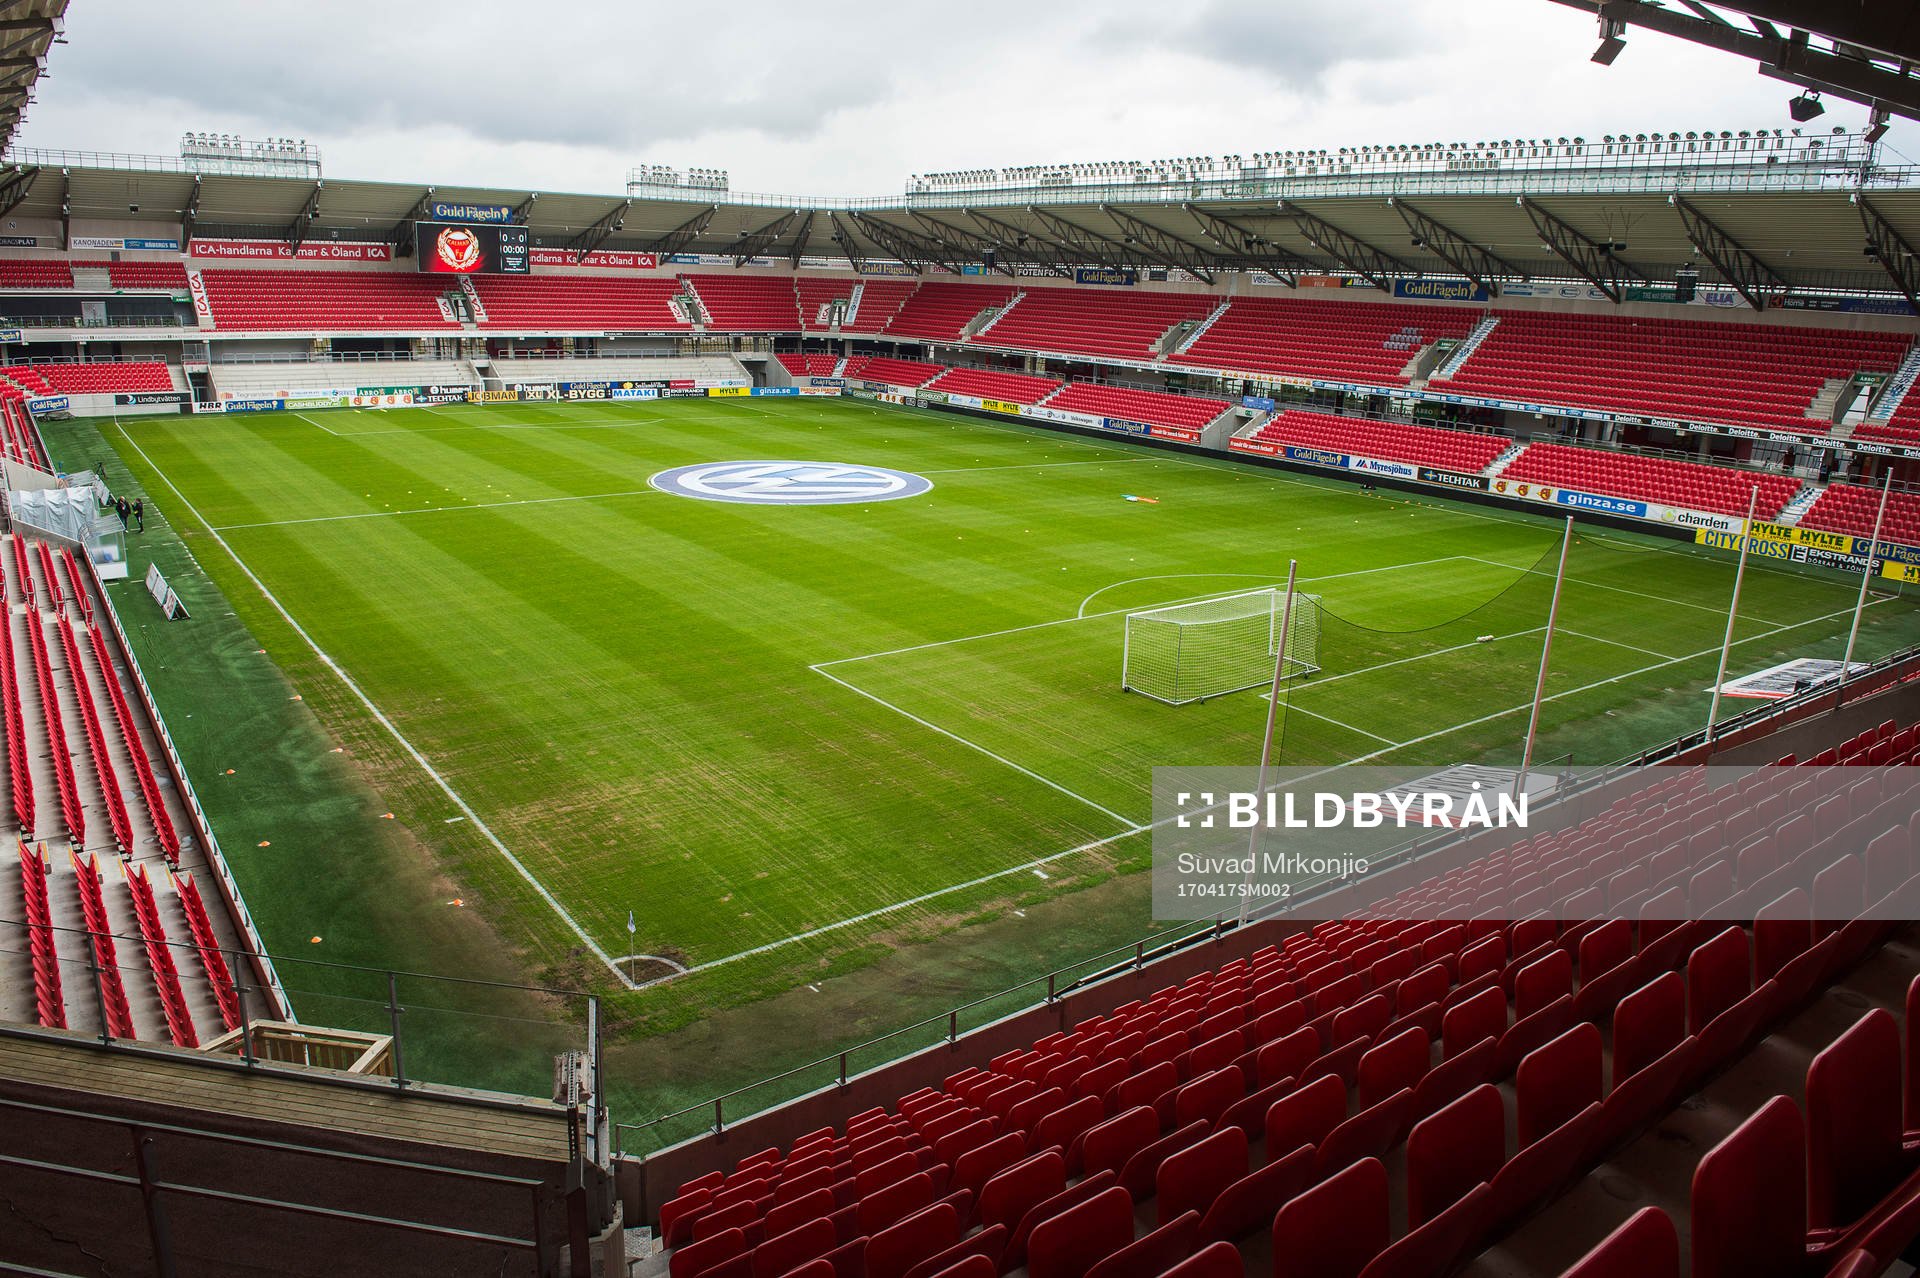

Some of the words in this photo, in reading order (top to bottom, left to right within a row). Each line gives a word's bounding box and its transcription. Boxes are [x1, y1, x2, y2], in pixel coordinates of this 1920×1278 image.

[436, 204, 464, 218] Guld
[466, 206, 501, 221] Fågeln
[502, 233, 508, 242] 0
[518, 234, 524, 243] 0
[195, 244, 273, 255] ICA-handlarna
[278, 247, 317, 257] Kamar
[320, 248, 329, 257] &
[331, 246, 361, 257] Öland
[367, 248, 386, 258] ICA
[503, 245, 525, 254] 00:00
[566, 256, 598, 264] Kamar
[600, 257, 607, 265] &
[608, 254, 633, 265] Öland
[637, 257, 653, 266] ICA
[1082, 271, 1098, 282] Guld
[1099, 271, 1122, 284] Fågeln
[1404, 281, 1432, 295] Guld
[1433, 282, 1468, 298] Fågeln
[468, 391, 516, 400] JOBMAN
[547, 390, 605, 399] XL-BYGG
[613, 389, 655, 397] MATAKI
[759, 387, 791, 395] ginza.se
[137, 394, 181, 403] Lindbytvätten
[427, 394, 463, 402] TECHTAK
[226, 401, 247, 410] Guld
[1108, 419, 1122, 430] Guld
[1615, 414, 1643, 424] Deloitte.
[1652, 418, 1681, 428] Deloitte.
[1689, 423, 1719, 433] Deloitte.
[1728, 427, 1760, 438] Deloitte.
[1769, 432, 1802, 443] Deloitte.
[1812, 437, 1846, 448] Deloitte.
[1857, 443, 1893, 454] Deloitte.
[1293, 448, 1312, 460] Guld
[1312, 450, 1337, 465] Fågeln
[1369, 460, 1413, 476] Myresjöhus
[1436, 473, 1481, 488] TECHTAK
[1567, 494, 1636, 513] ginza.se
[1677, 512, 1729, 530] charden
[1751, 521, 1793, 538] HYLTE
[1800, 529, 1845, 547] HYLTE
[1808, 549, 1880, 568] EKSTRANDS
[1846, 564, 1879, 575] FÖNSER
